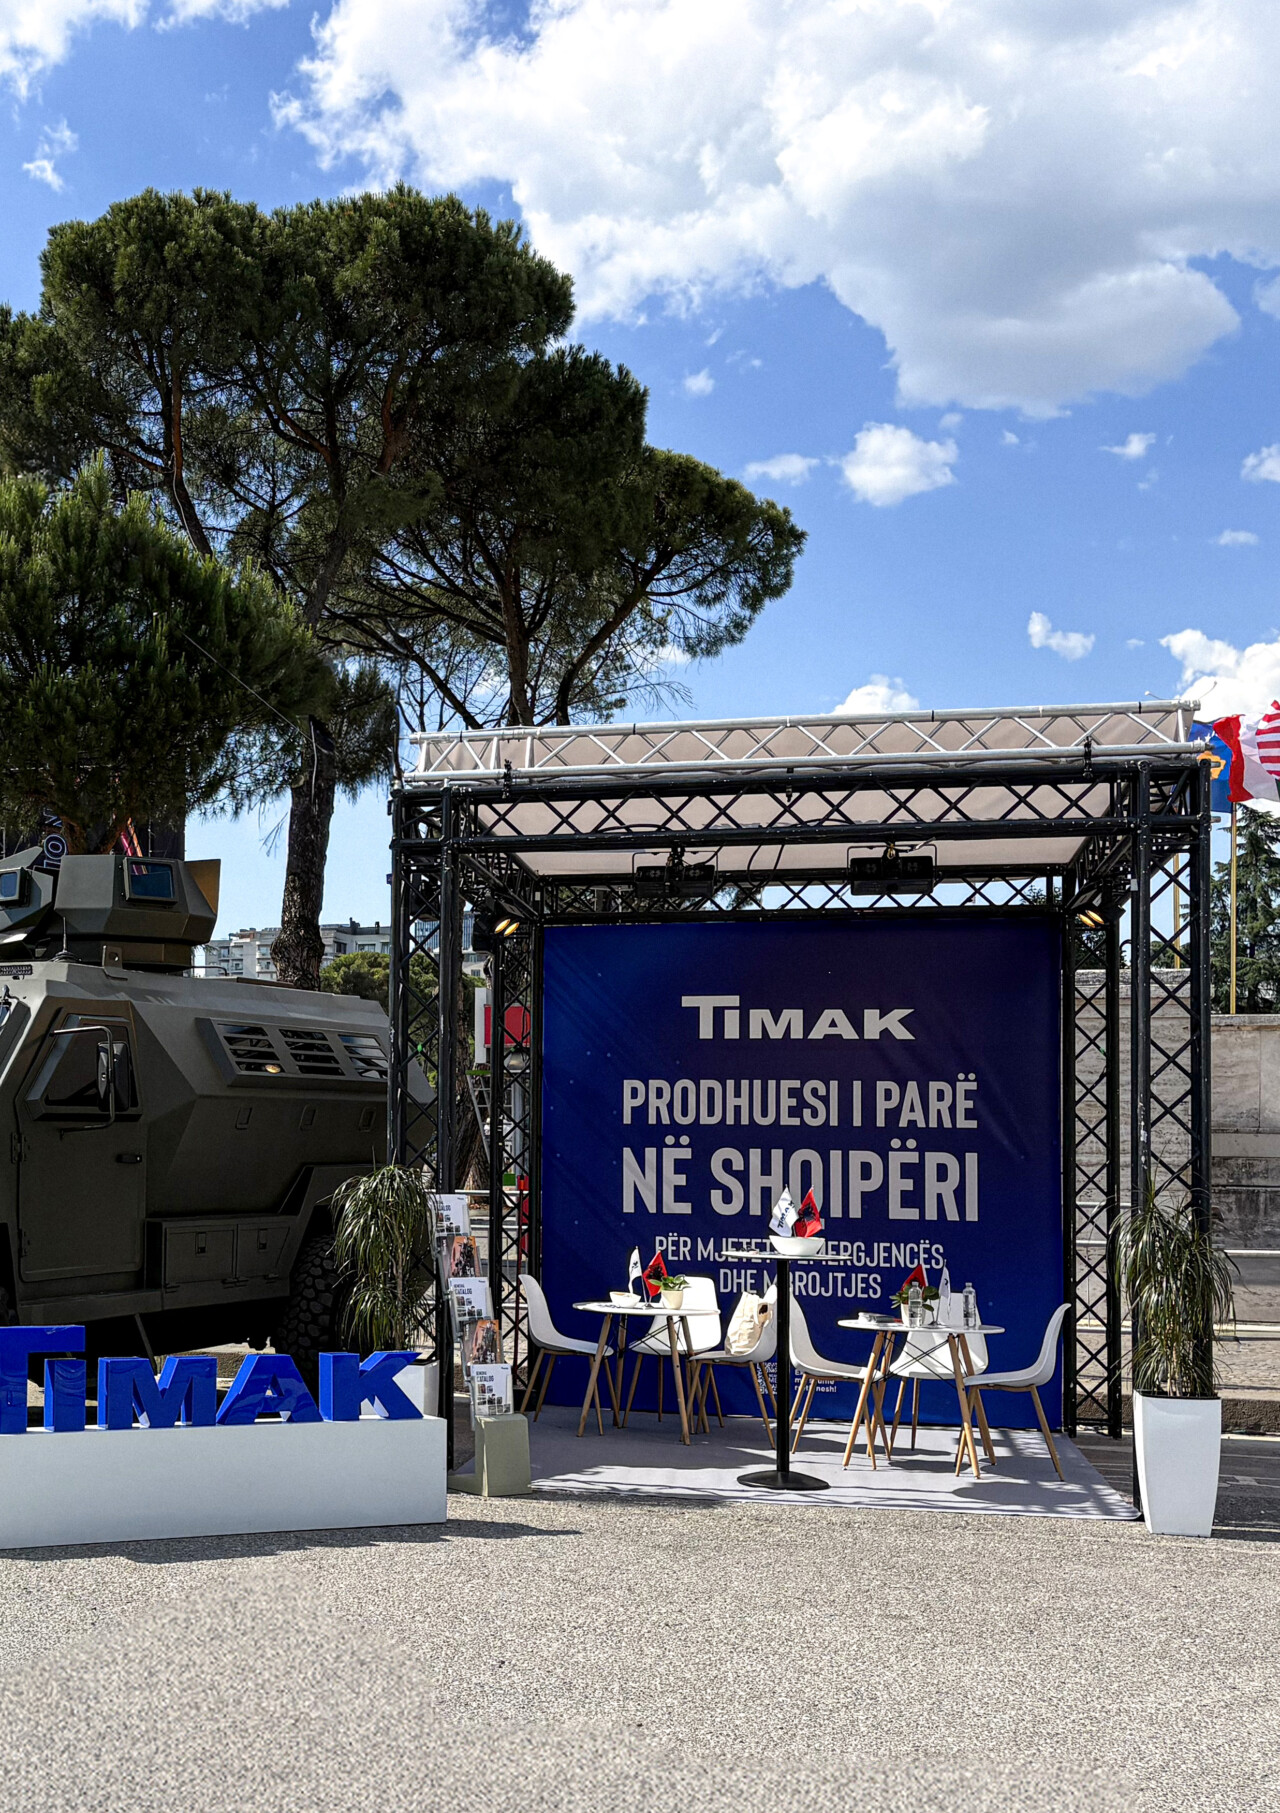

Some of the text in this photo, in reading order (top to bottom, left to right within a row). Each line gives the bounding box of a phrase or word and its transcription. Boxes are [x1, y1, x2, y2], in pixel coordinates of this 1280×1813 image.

[622, 1072, 978, 1129] PRODHUESI I PARË
[622, 1135, 979, 1230] NË SHQIPËRI
[655, 1232, 691, 1261] PËR
[719, 1268, 757, 1294] DHE
